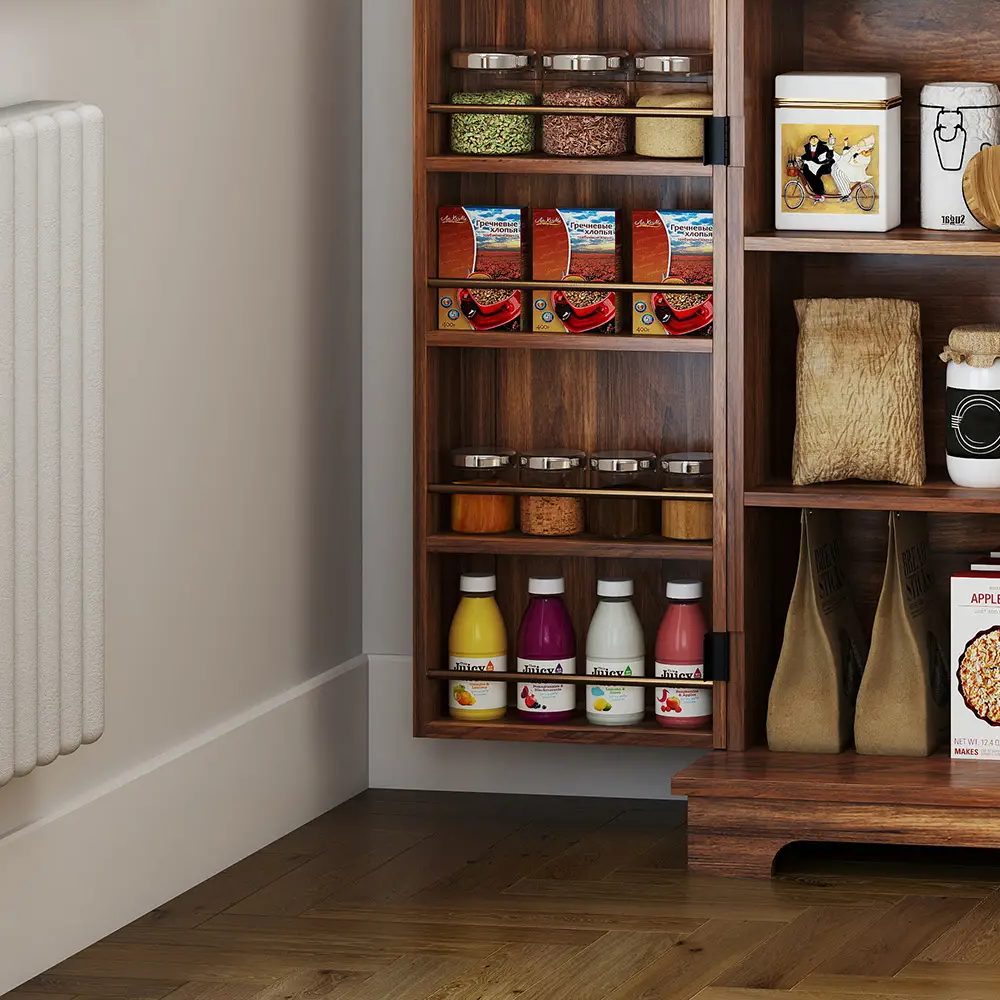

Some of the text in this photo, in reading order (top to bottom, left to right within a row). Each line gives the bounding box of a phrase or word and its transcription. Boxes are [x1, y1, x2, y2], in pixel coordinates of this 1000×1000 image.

[476, 220, 518, 228] Гречневые
[570, 222, 613, 230] Гречневые
[670, 224, 713, 232] Гречневые
[954, 748, 979, 756] MAKES
